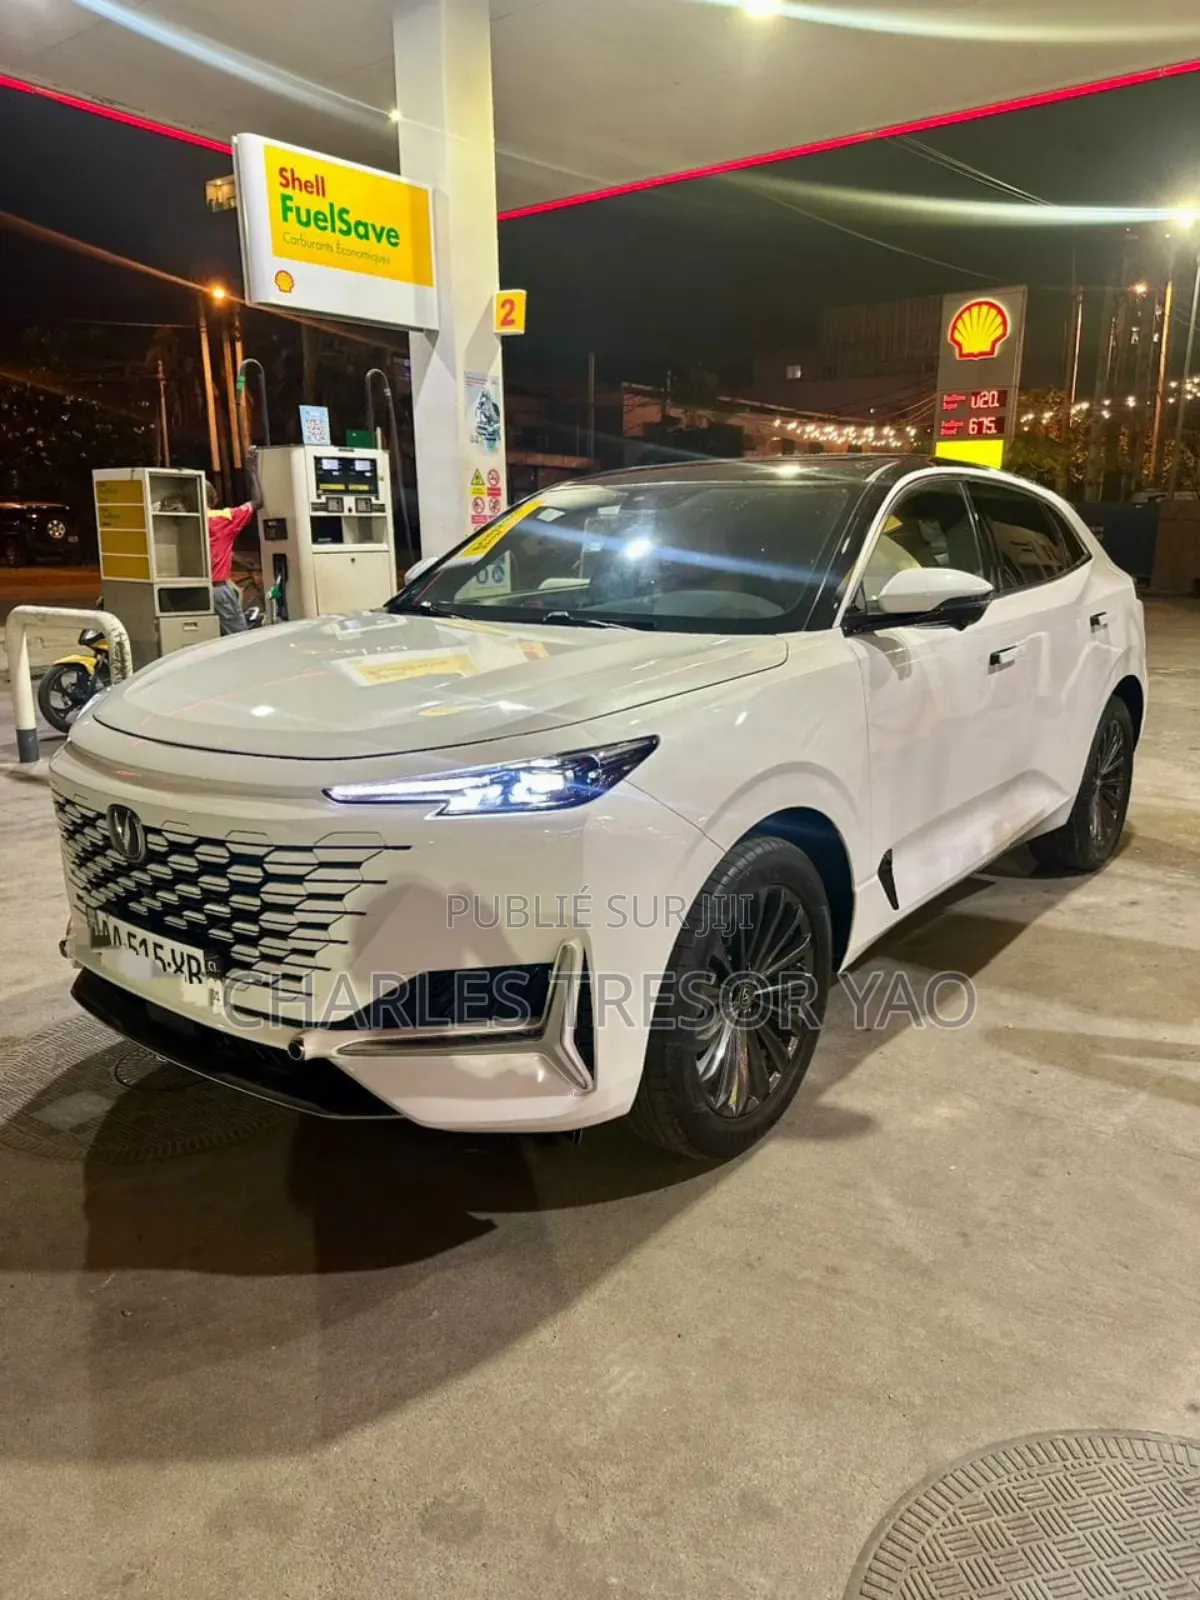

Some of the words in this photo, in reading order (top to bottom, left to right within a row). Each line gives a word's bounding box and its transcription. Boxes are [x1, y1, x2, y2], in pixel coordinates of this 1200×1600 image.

[279, 167, 326, 198] Shell
[280, 193, 401, 248] FuelSave
[283, 231, 334, 253] Carburants
[499, 298, 516, 327] 2
